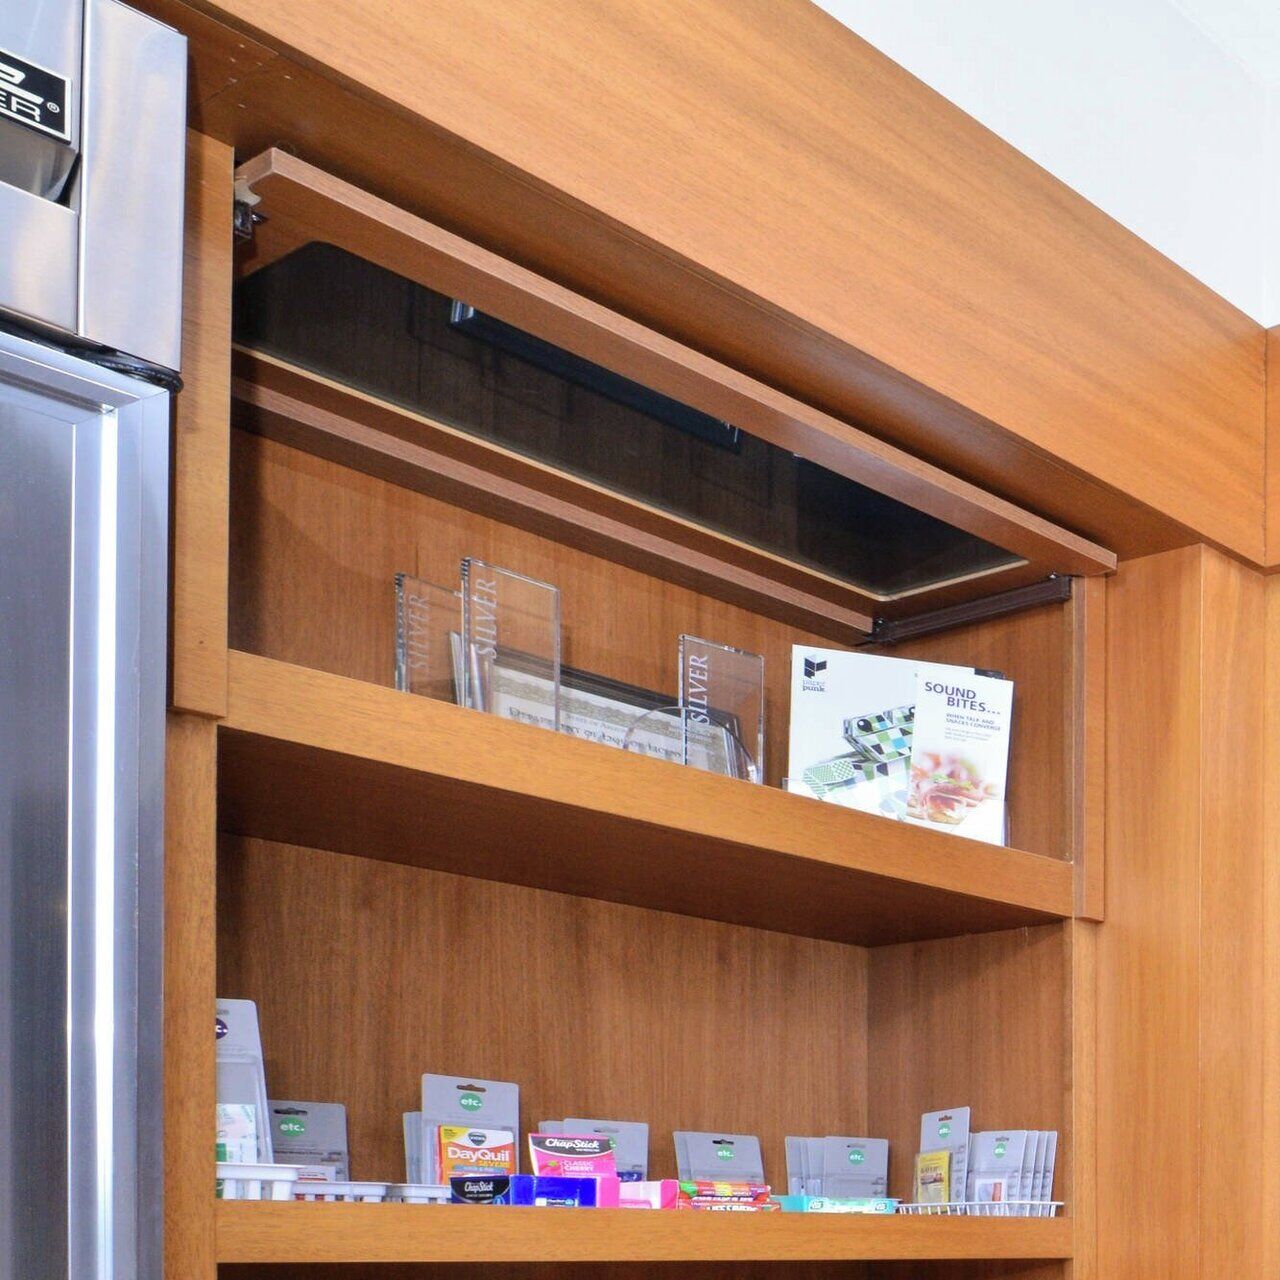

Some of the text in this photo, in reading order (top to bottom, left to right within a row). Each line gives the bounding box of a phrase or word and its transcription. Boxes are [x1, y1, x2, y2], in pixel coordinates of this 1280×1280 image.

[924, 681, 976, 700] SOUND
[280, 1122, 306, 1133] etc.
[545, 1138, 600, 1151] ChapStick
[448, 1147, 510, 1168] DayQuil
[566, 1166, 594, 1174] CHERRY
[464, 1181, 494, 1193] ChapStick
